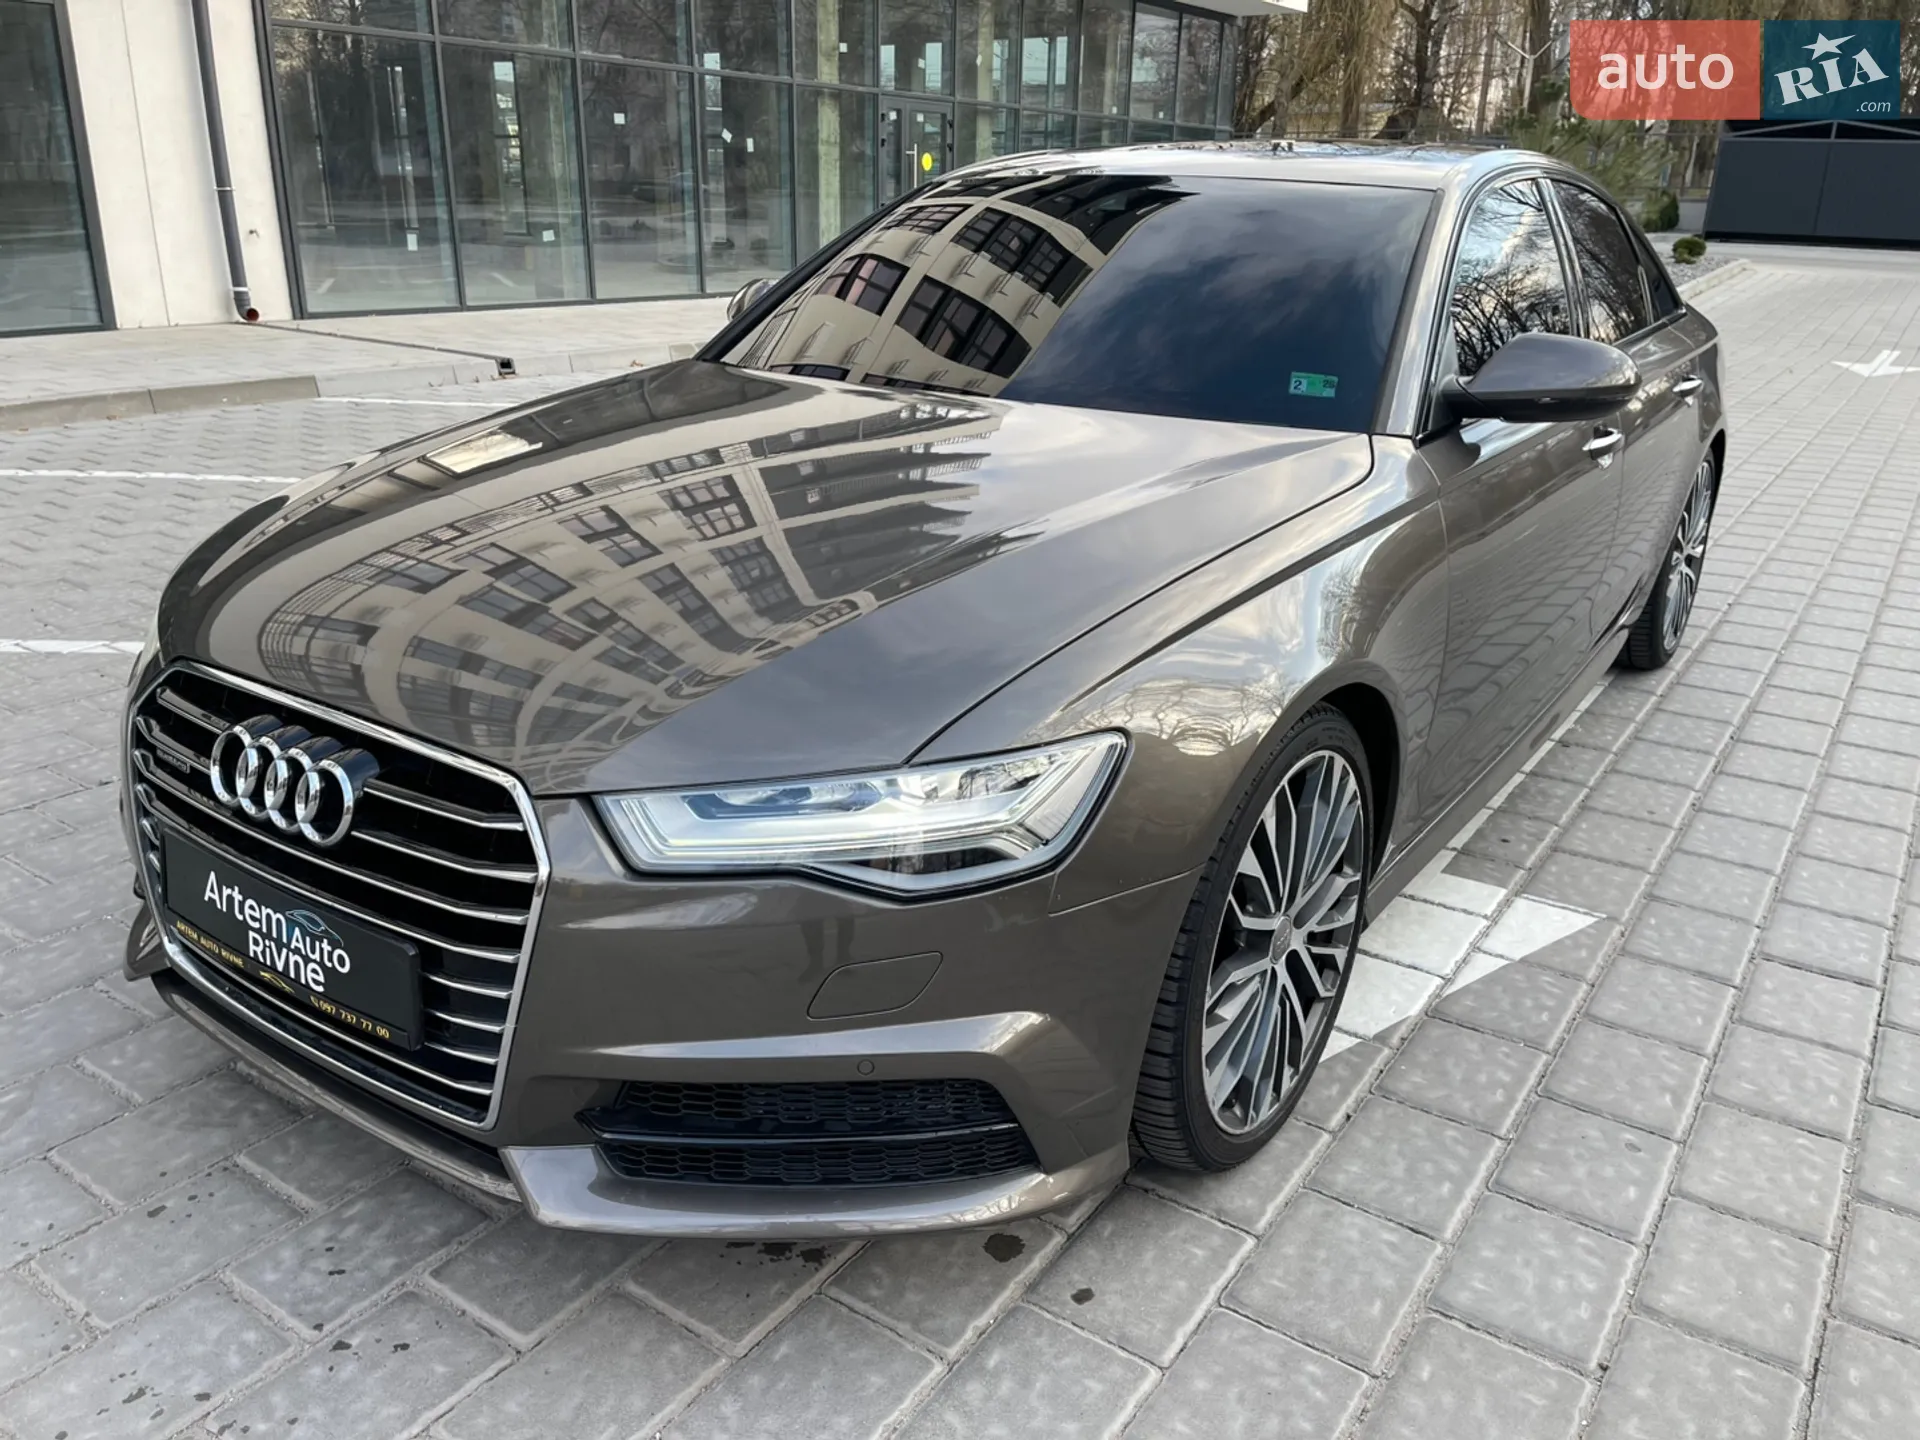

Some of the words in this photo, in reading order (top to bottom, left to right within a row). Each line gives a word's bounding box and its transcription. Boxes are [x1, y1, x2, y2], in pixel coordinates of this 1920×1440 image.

[1293, 380, 1302, 391] 2
[204, 870, 288, 943] Artem
[290, 926, 351, 974] Auto
[360, 1018, 372, 1031] 77
[376, 1026, 390, 1039] 00
